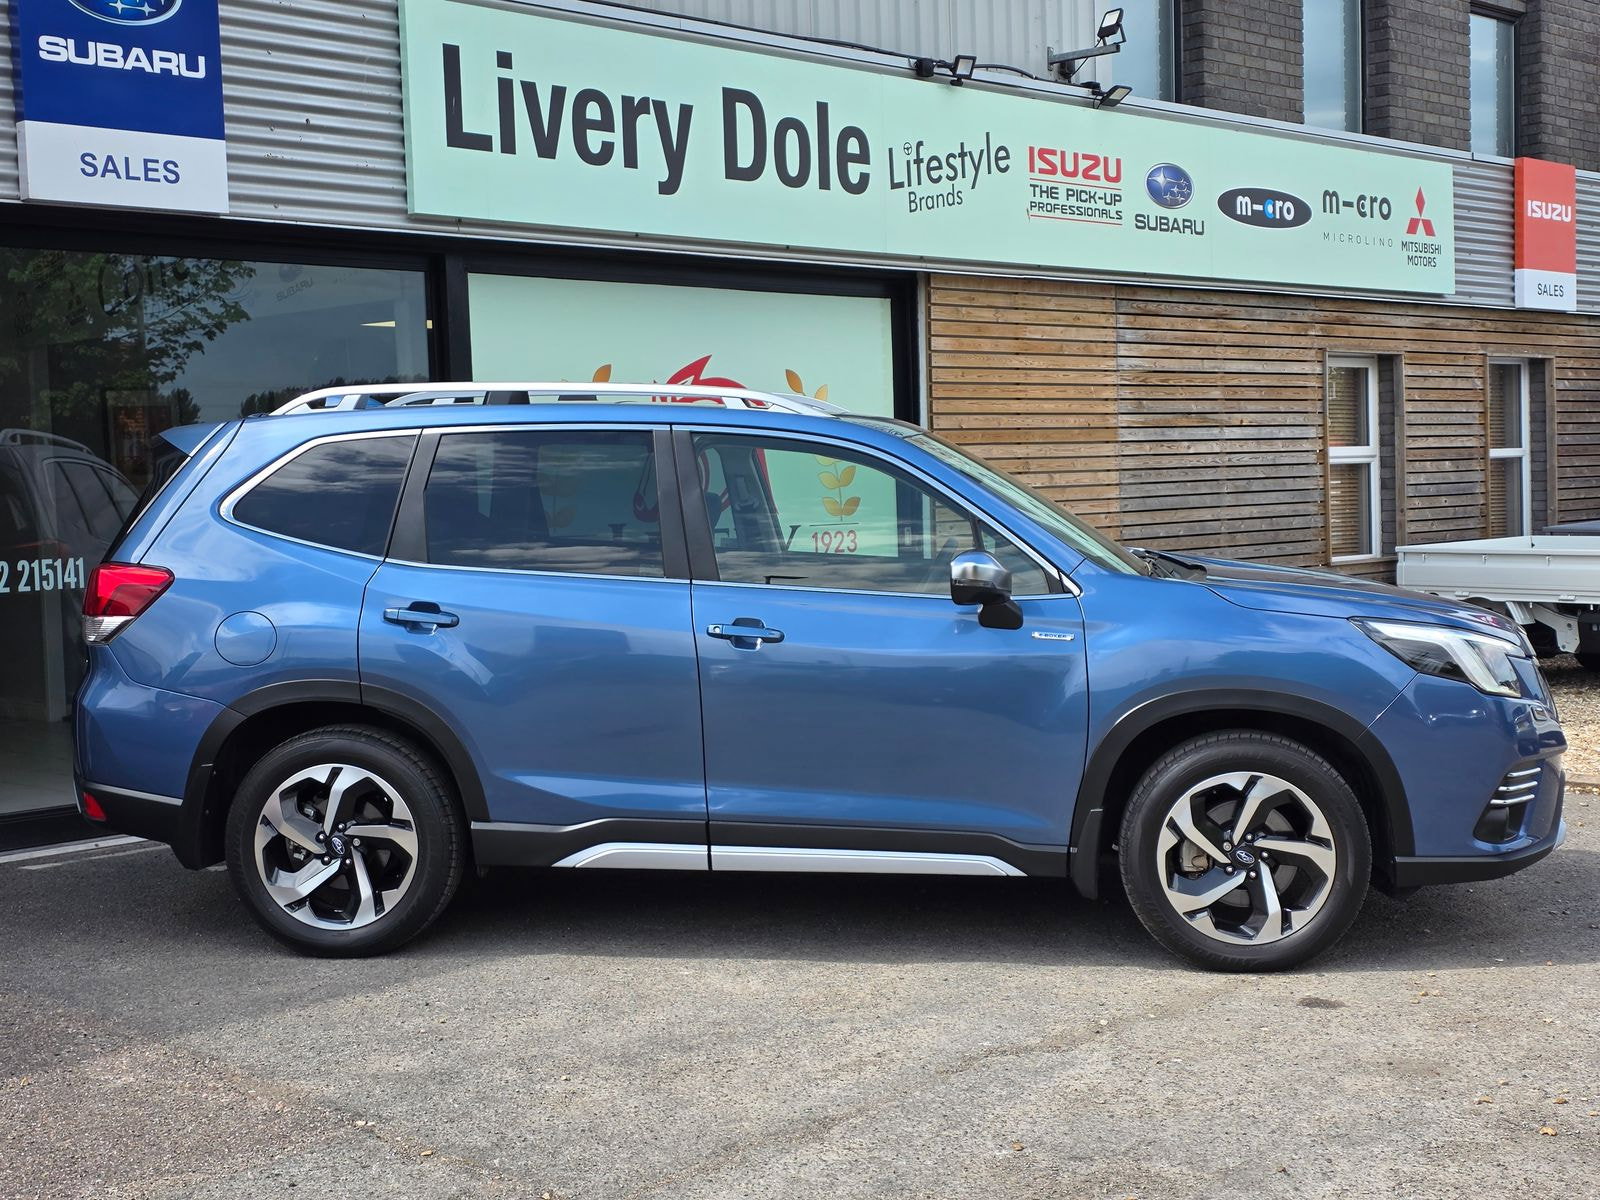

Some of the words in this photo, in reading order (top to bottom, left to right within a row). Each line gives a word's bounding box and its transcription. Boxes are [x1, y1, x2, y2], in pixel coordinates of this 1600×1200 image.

[38, 35, 206, 79] SUBARU
[442, 43, 694, 195] Livery
[722, 87, 871, 195] Dole
[80, 152, 181, 185] SALES
[888, 132, 1011, 190] Lifestyle
[1029, 146, 1122, 183] ISUZU
[908, 184, 964, 213] Brands
[1029, 183, 1060, 200] THE
[1066, 188, 1122, 206] PICK-UP
[1029, 200, 1123, 220] PROFESSIONALS
[1527, 199, 1572, 223] ISUZU
[1134, 213, 1205, 236] SUBARU
[1322, 231, 1394, 248] MICROLINO
[1401, 240, 1442, 256] MITSUBISHI
[1407, 255, 1437, 268] MOTORS
[1537, 282, 1565, 298] SALES
[811, 529, 858, 553] 1923
[17, 556, 85, 592] 215141
